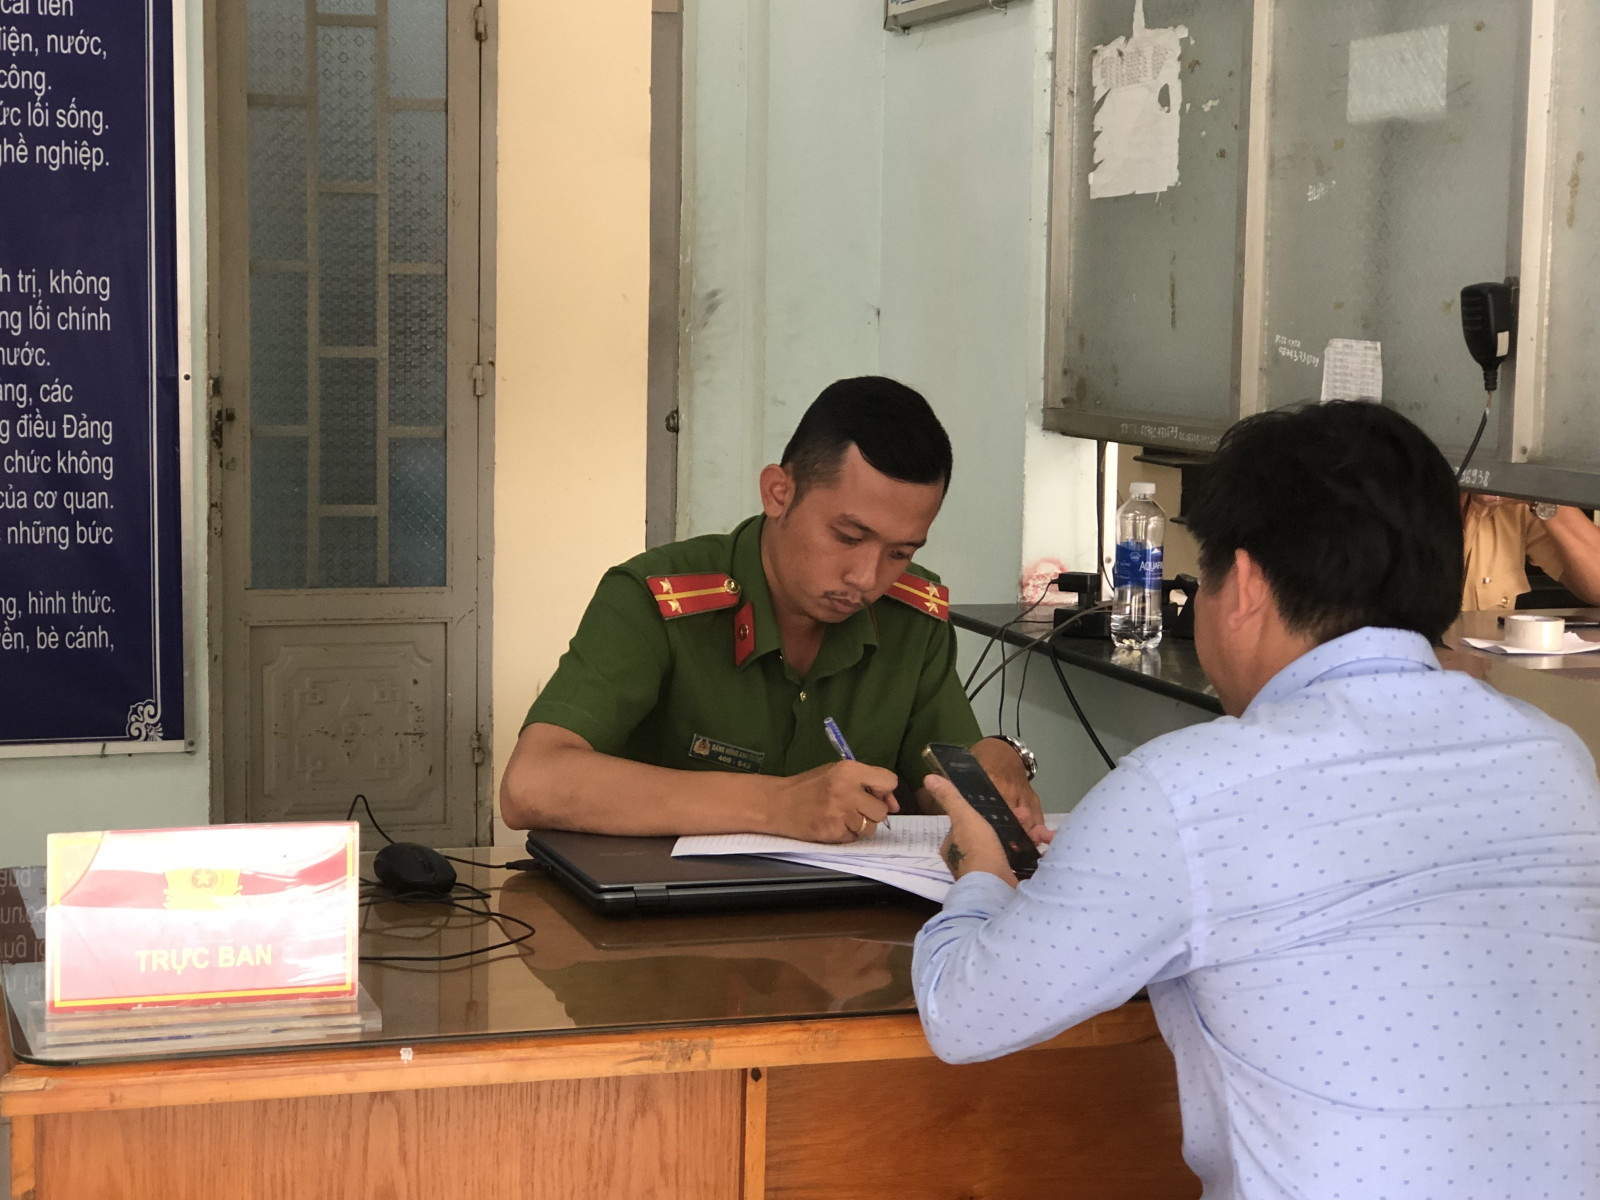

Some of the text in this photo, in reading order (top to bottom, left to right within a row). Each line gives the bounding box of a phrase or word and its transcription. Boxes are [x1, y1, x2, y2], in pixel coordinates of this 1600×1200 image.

[0, 25, 107, 60] iện, nước,
[27, 96, 49, 128] lối
[55, 97, 109, 136] sống.
[0, 132, 110, 172] hề nghiệp.
[17, 268, 42, 299] trị,
[49, 268, 111, 302] không
[28, 299, 51, 331] lối
[57, 305, 111, 331] chính
[39, 377, 74, 403] các
[16, 408, 56, 439] điều
[62, 412, 113, 446] Đảng
[3, 449, 114, 481] chức không
[33, 490, 58, 509] cơ
[63, 491, 114, 515] quan.
[7, 520, 114, 551] những bức
[28, 590, 66, 614] hình
[72, 589, 116, 614] thức.
[0, 620, 114, 653] ền, bè cánh,
[134, 943, 272, 976] TRỰC BAN
